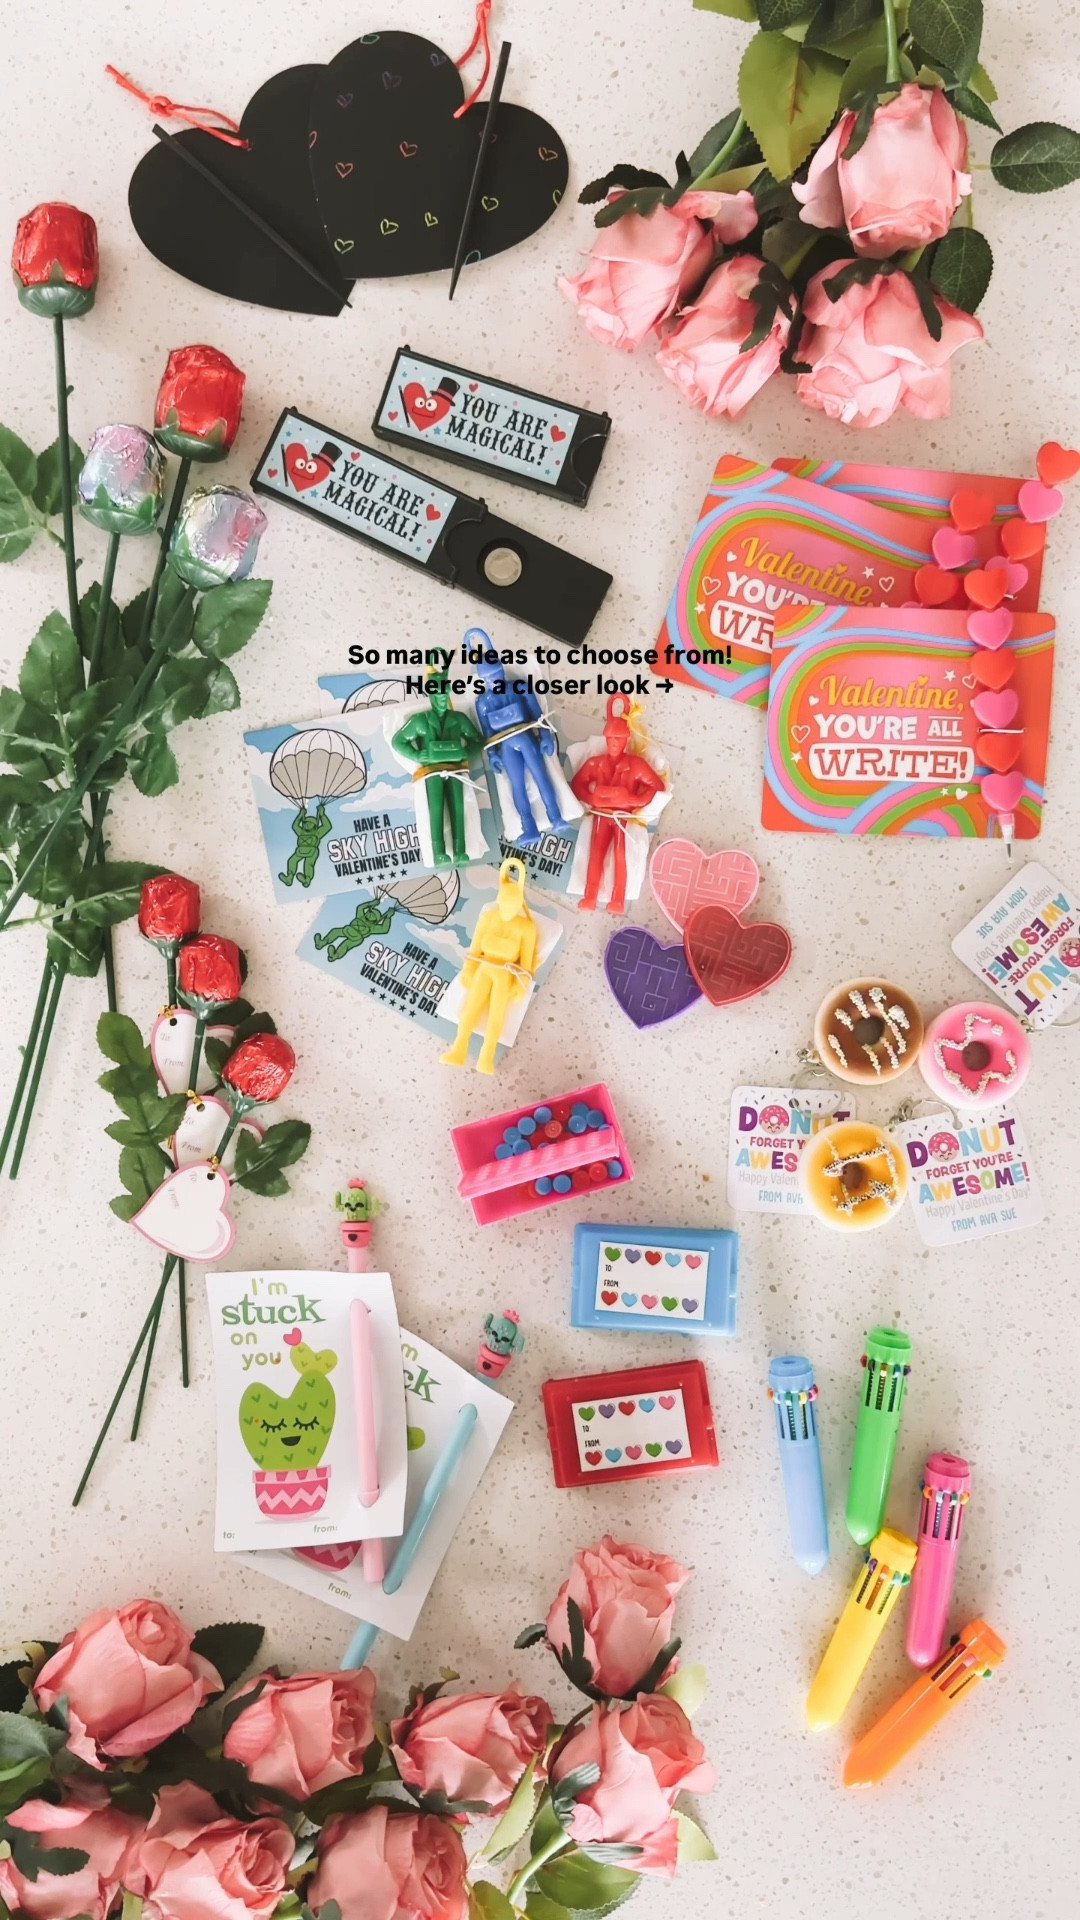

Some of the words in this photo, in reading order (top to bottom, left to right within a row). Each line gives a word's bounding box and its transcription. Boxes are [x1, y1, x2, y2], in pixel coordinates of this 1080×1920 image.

[459, 392, 500, 423] YOU
[503, 409, 549, 441] ARE
[445, 414, 549, 466] MAGICAL!
[338, 459, 380, 494] YOU
[380, 482, 425, 517] ARE
[322, 479, 422, 542] MAGICAL!
[819, 674, 964, 714] Valentine,
[813, 712, 918, 741] YOU'RE
[927, 719, 963, 738] ALL
[814, 748, 968, 780] WRITE!
[353, 815, 381, 833] HAVE
[383, 813, 391, 828] A
[327, 833, 368, 863] SKY
[334, 853, 399, 878] VALENTINE'S
[538, 857, 563, 877] DAY!
[1009, 886, 1028, 909] FROM
[1029, 885, 1056, 910] Happy
[991, 906, 1009, 924] AVA
[976, 921, 994, 939] SUE
[982, 892, 1071, 985] AWESOME!
[1041, 916, 1075, 954] FORGET
[365, 940, 410, 978] SKY
[402, 942, 430, 966] HAVE
[428, 957, 439, 970] A
[1008, 952, 1043, 985] YOU'RE
[360, 963, 419, 1005] VALENTINE'S
[750, 1136, 795, 1149] FORGET
[906, 1118, 1016, 1168] DONUT
[739, 1170, 769, 1186] Happy
[926, 1161, 970, 1180] FORGET
[972, 1151, 1014, 1170] YOU'RE
[759, 1190, 782, 1203] FROM
[919, 1161, 1031, 1204] AWESOME!
[925, 1202, 957, 1219] Happy
[956, 1191, 1011, 1212] Valentine's
[1011, 1184, 1031, 1200] Day!
[951, 1217, 977, 1232] FROM
[979, 1212, 998, 1227] AVA
[1000, 1207, 1018, 1221] SUE
[251, 1277, 288, 1296] I'm
[221, 1293, 328, 1326] stuck
[230, 1331, 258, 1346] on
[241, 1351, 281, 1371] you
[223, 1531, 236, 1539] to:
[313, 1524, 338, 1533] from:
[328, 1582, 352, 1600] from:
